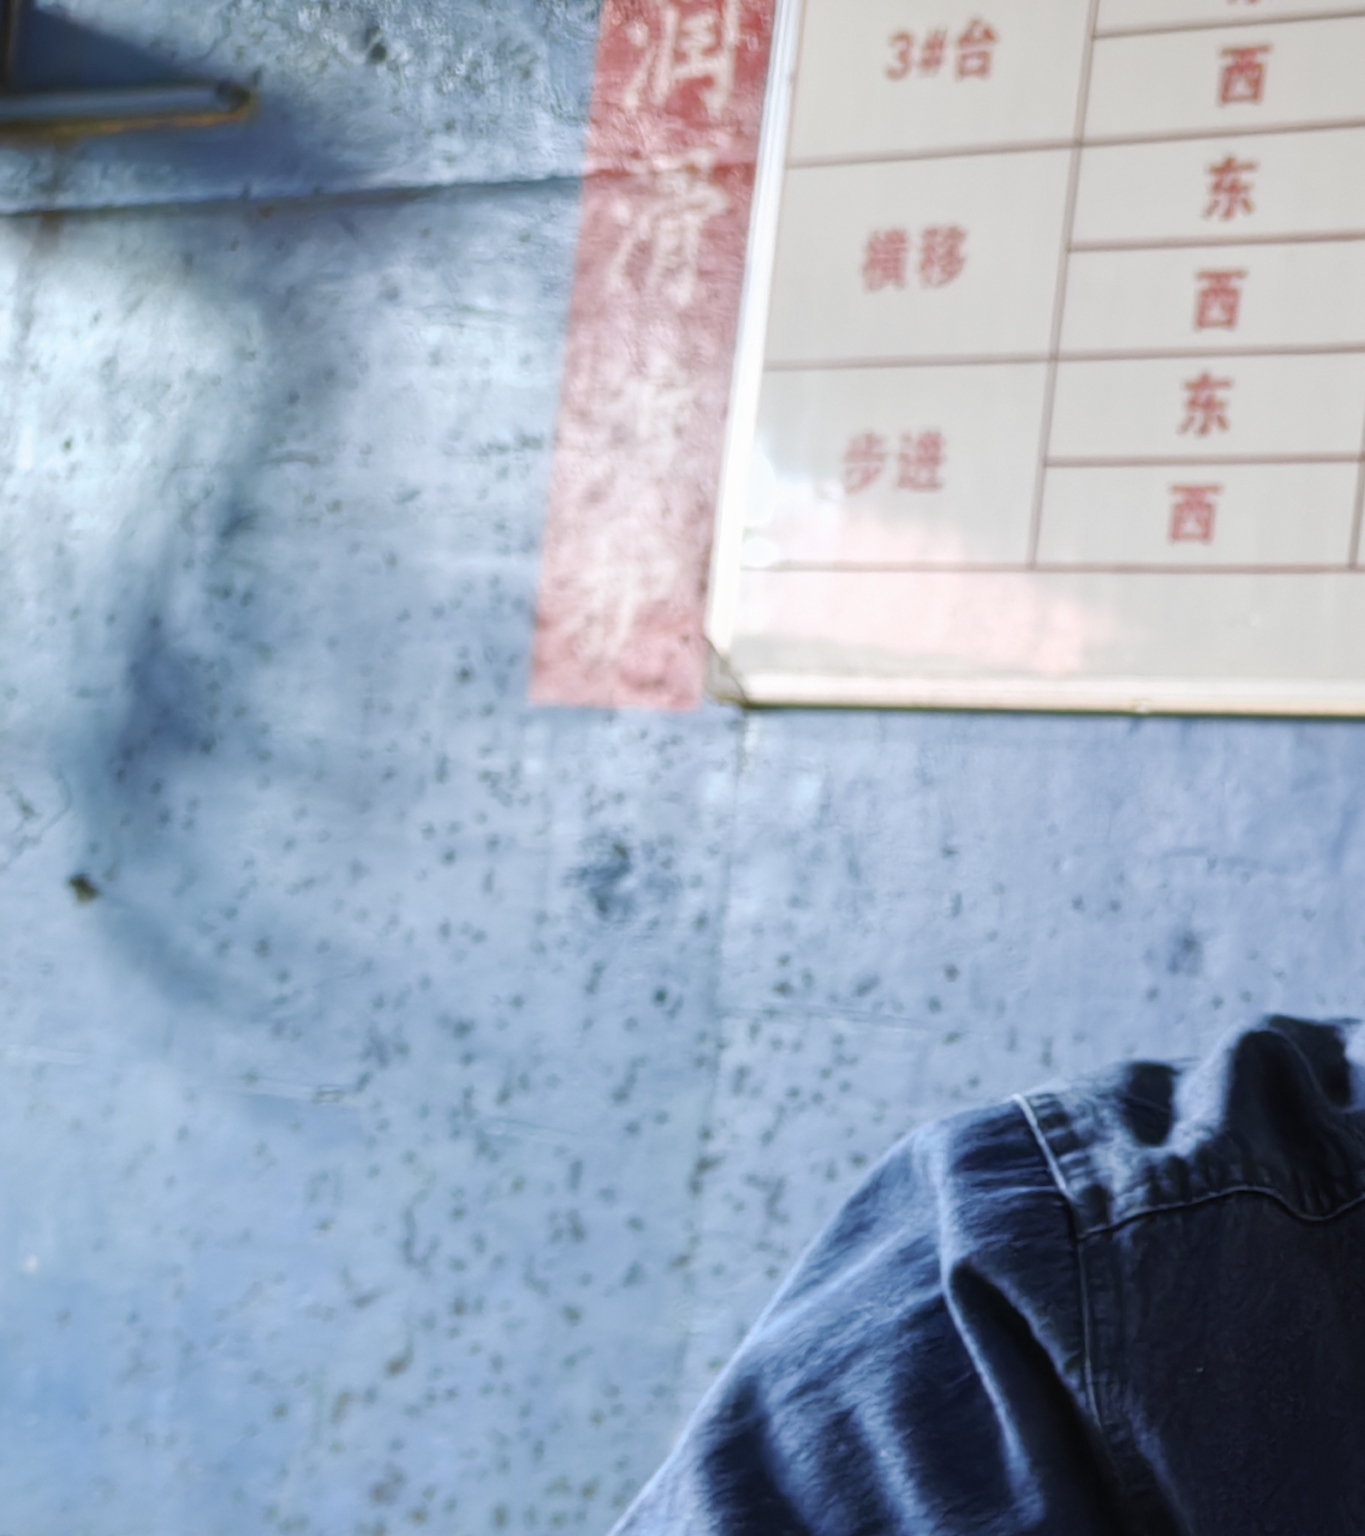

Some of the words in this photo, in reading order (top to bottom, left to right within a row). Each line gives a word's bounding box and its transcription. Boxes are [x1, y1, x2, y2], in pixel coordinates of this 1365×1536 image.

[884, 20, 998, 82] 3#台
[1217, 44, 1272, 108] 西
[1204, 155, 1258, 221] 东
[861, 225, 968, 292] 横移
[1193, 268, 1247, 331] 西
[1179, 372, 1233, 436] 东
[843, 430, 946, 494] 步进
[1168, 484, 1222, 545] 西
